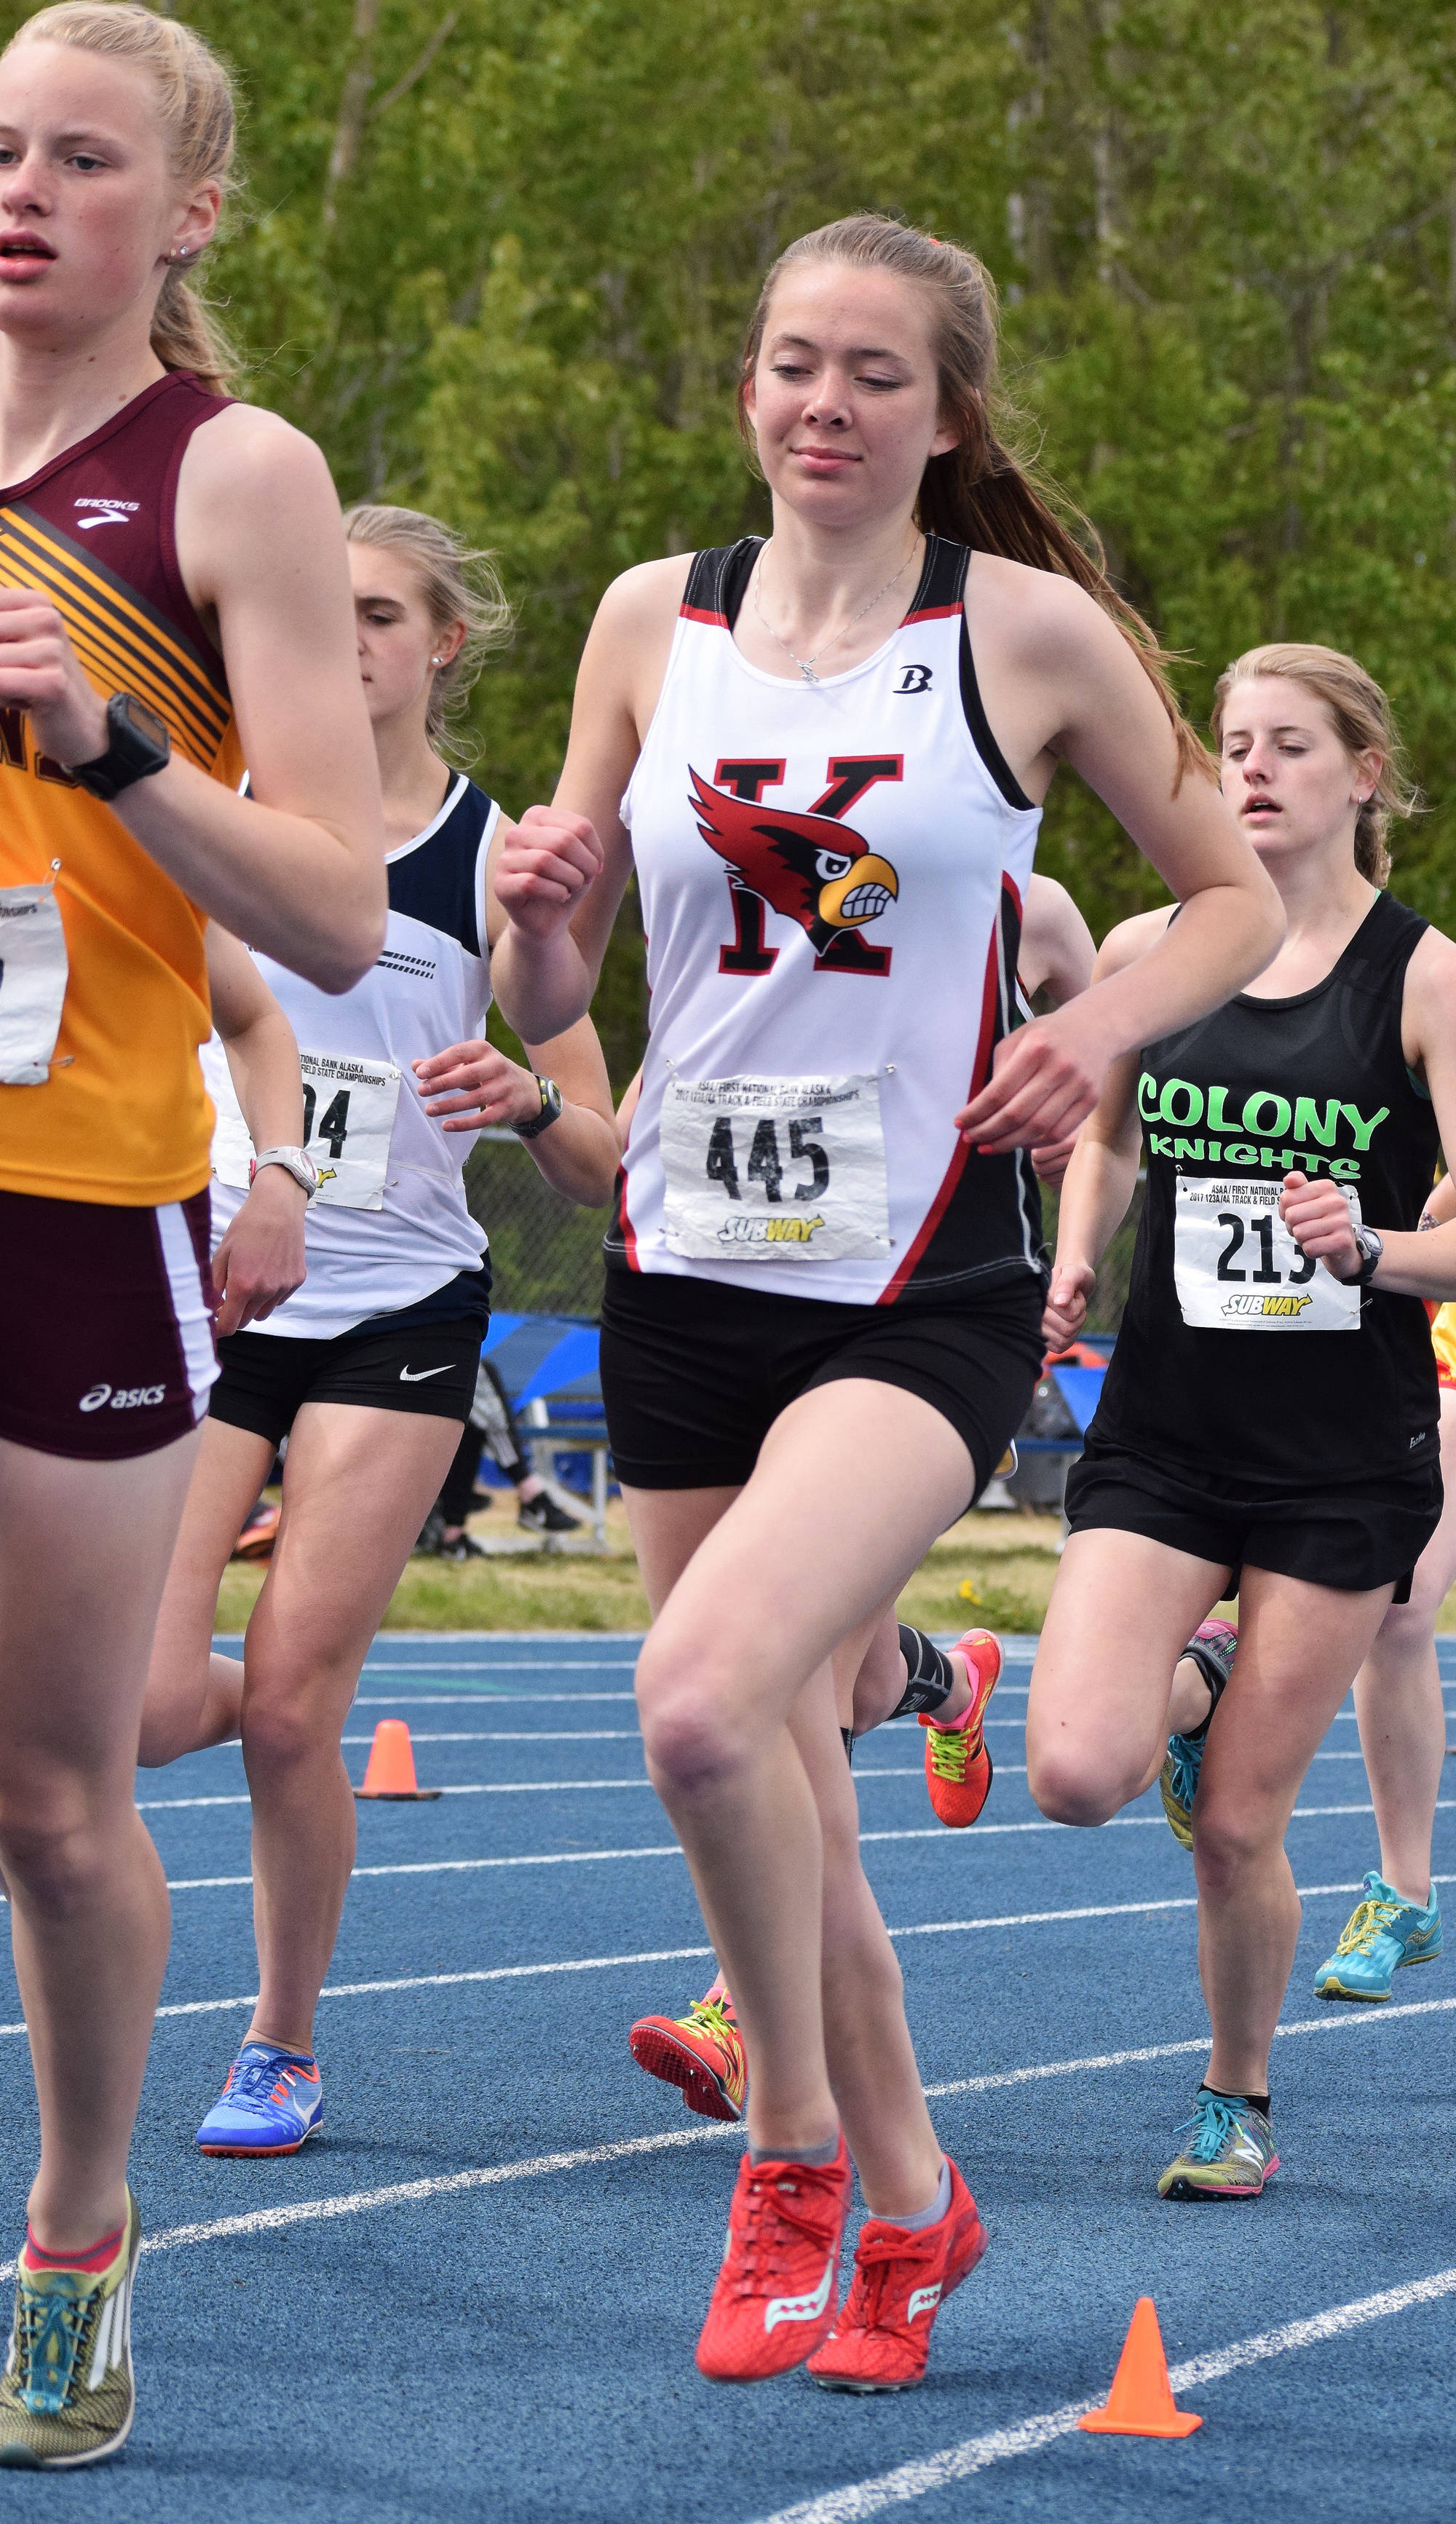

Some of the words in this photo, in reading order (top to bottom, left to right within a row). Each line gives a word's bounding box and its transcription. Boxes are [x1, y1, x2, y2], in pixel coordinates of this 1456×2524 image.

[74, 498, 141, 511] BROOKS
[713, 753, 905, 977] K
[300, 1054, 320, 1067] TIONAL
[321, 1059, 338, 1069] BANK
[339, 1061, 363, 1074] ALASKA
[301, 1064, 316, 1075] FIELD
[317, 1067, 335, 1078] STATE
[336, 1070, 386, 1086] CHAMPIONSHIPS
[1137, 1072, 1390, 1151] COLONY
[706, 1117, 830, 1202] 445
[1150, 1133, 1361, 1179] KNIGHTS
[1190, 1192, 1203, 1202] 2017
[1205, 1194, 1230, 1204] 123A/4A
[1232, 1195, 1251, 1205] TRACK
[1253, 1195, 1258, 1205] &
[1259, 1196, 1275, 1206] FIELD
[1232, 1185, 1249, 1195] FIRST
[1250, 1186, 1278, 1196] NATIONAL
[717, 1214, 826, 1244] SUBWAY
[1222, 1293, 1313, 1316] SUBWAY
[110, 1384, 167, 1409] asics
